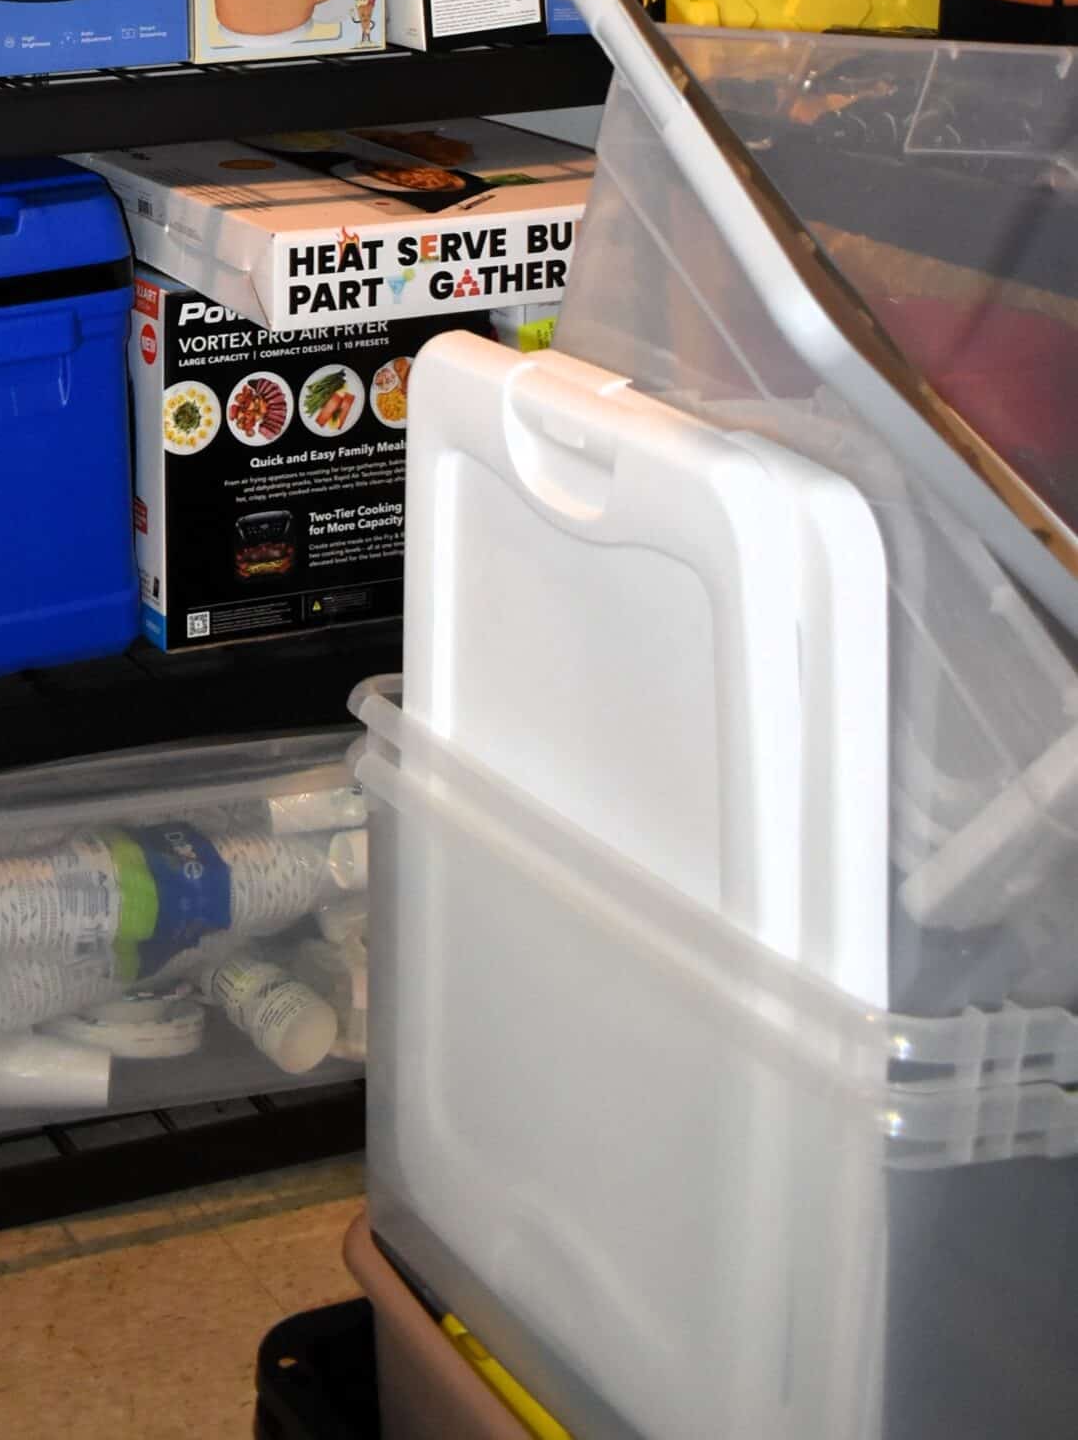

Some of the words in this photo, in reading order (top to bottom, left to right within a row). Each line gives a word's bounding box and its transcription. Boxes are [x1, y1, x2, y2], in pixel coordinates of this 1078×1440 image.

[289, 240, 383, 277] HEAT
[397, 228, 506, 266] SERVE
[528, 221, 573, 254] BU
[178, 331, 253, 353] VORTEX
[257, 329, 295, 345] PRO
[299, 327, 328, 341] AIR
[334, 320, 389, 337] FRYER
[178, 356, 207, 368] LARGE
[208, 352, 250, 364] CAPACITY
[259, 346, 301, 359] COMPACT
[302, 343, 333, 354] DESIGN
[344, 341, 354, 349] 10
[354, 337, 390, 348] PRESETS
[249, 454, 284, 469] Quick
[286, 451, 308, 464] and
[310, 448, 336, 464] Easy
[338, 444, 375, 461] Family
[308, 507, 356, 523] Two-Tier
[357, 502, 403, 518] Cooking
[308, 522, 325, 536] for
[327, 519, 356, 534] More
[357, 515, 404, 531] Capacity
